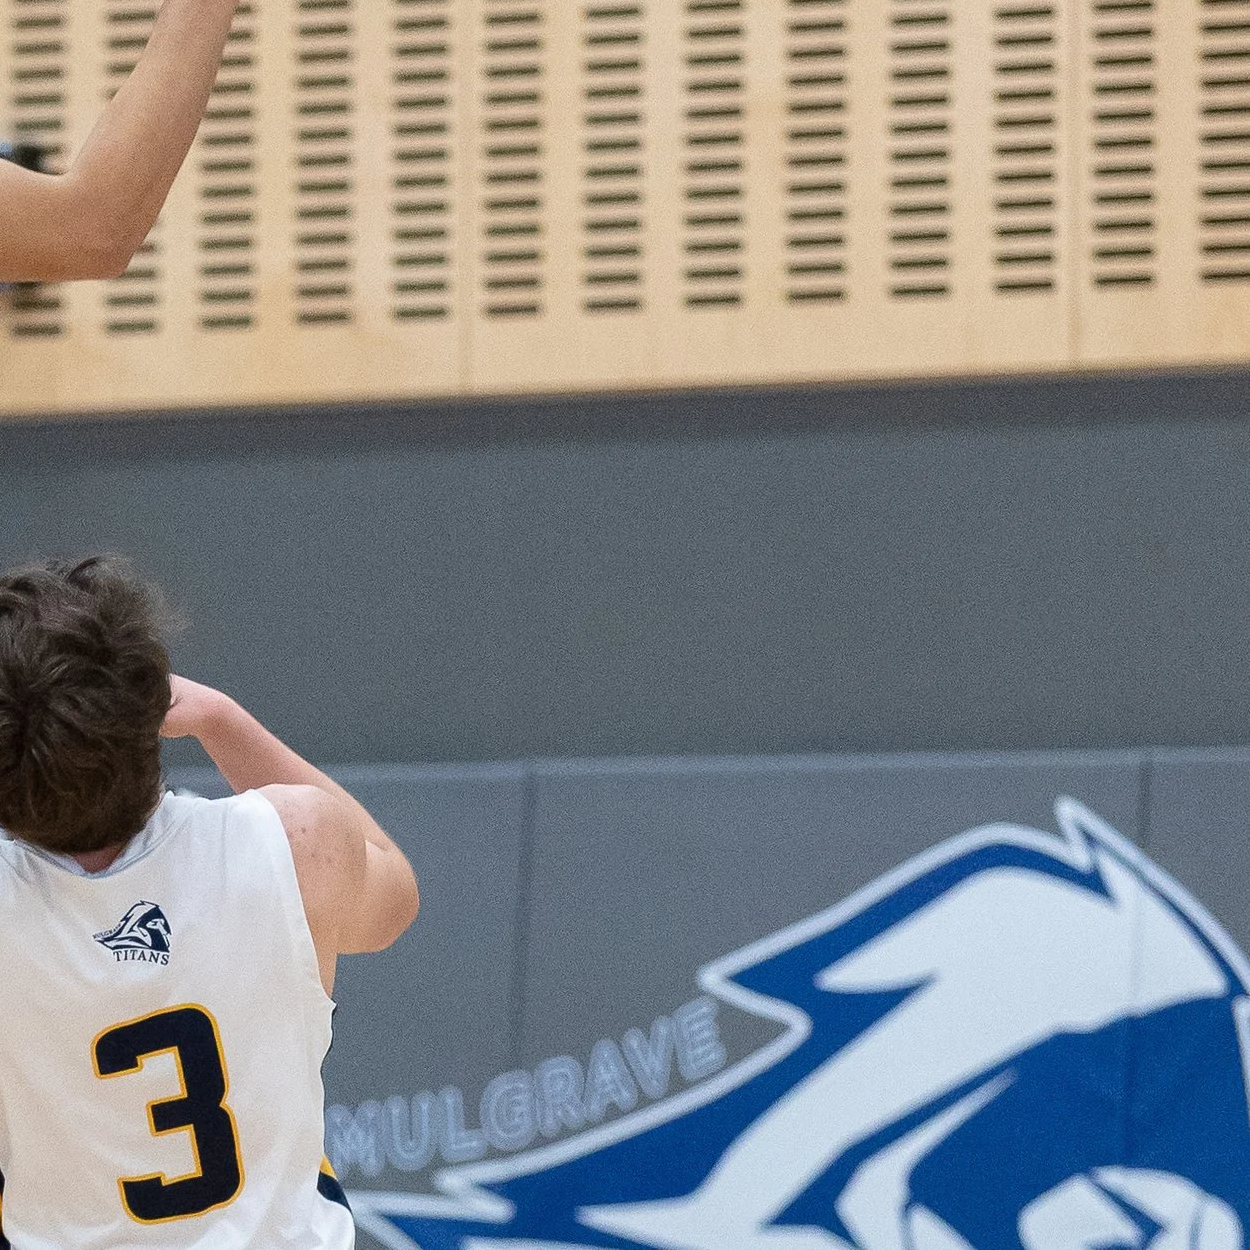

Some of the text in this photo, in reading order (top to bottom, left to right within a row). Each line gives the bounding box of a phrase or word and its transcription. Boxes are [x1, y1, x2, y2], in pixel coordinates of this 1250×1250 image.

[112, 949, 170, 966] TITANS
[90, 1002, 245, 1226] 3
[325, 996, 727, 1178] MULGRAVE
